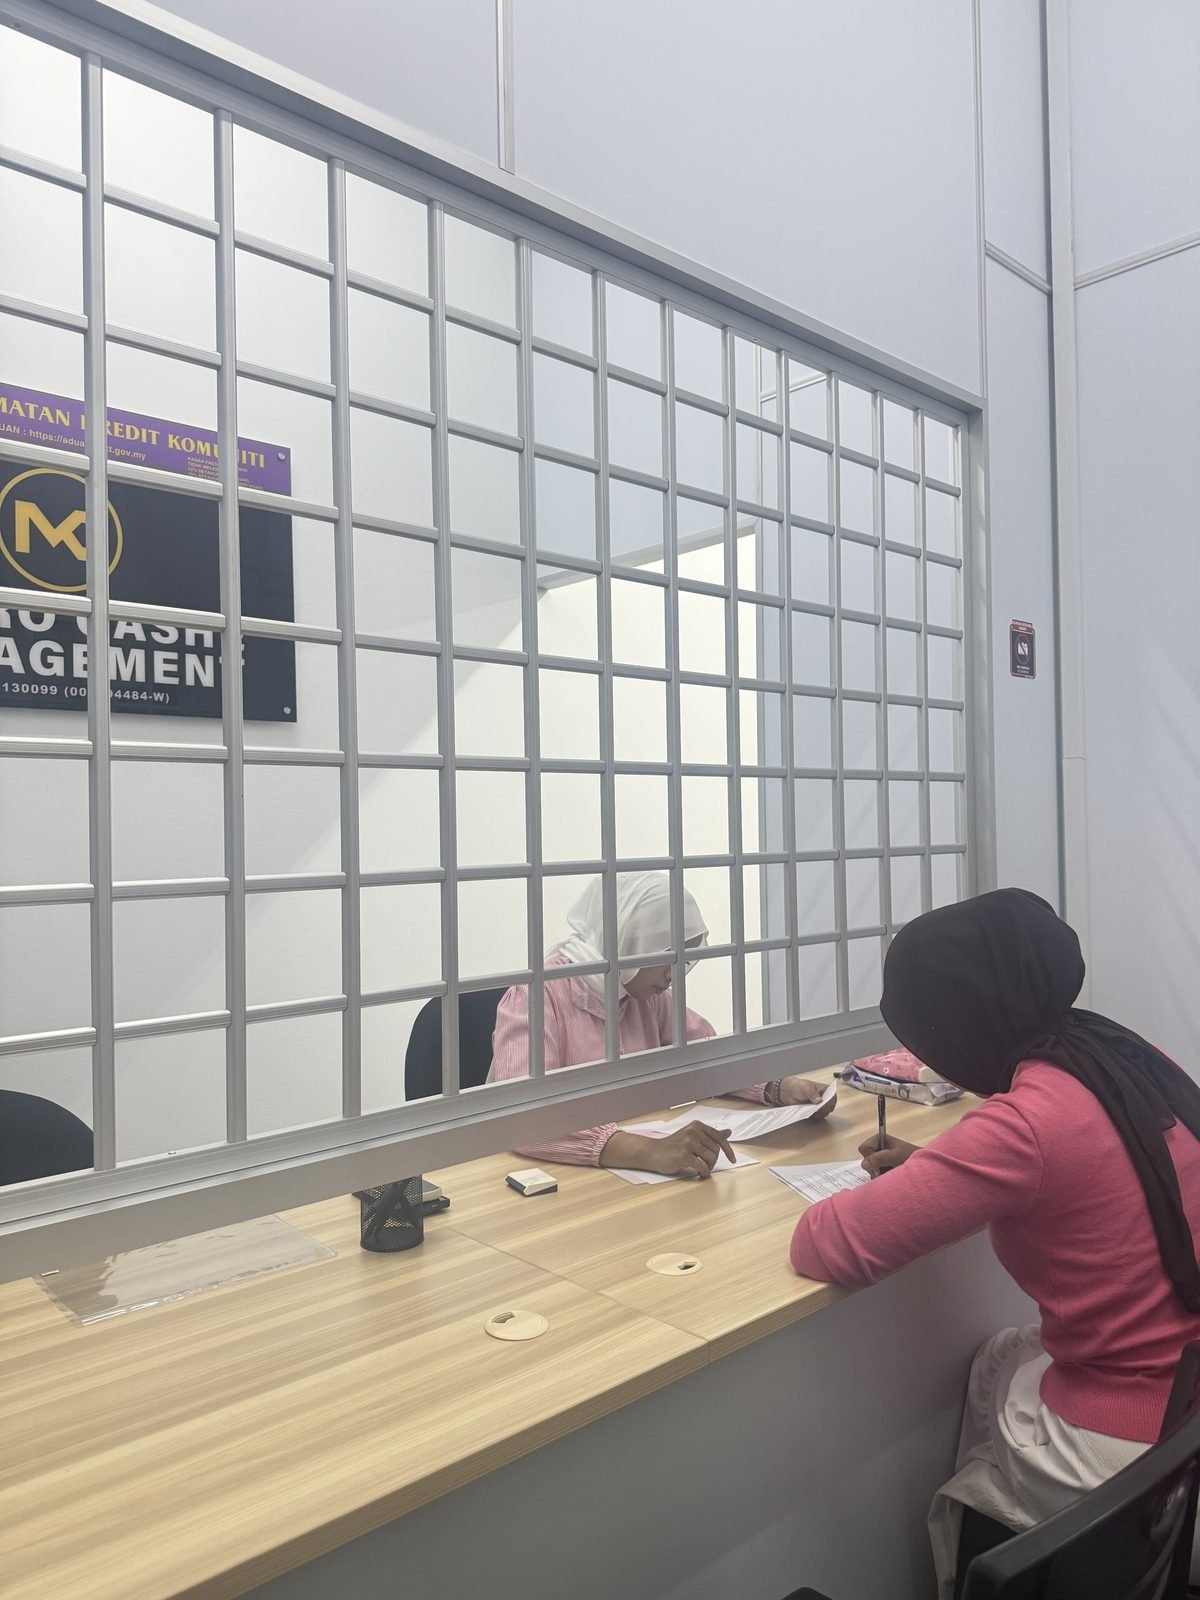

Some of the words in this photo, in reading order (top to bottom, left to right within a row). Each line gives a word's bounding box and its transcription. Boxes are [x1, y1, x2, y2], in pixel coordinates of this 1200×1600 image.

[168, 433, 265, 469] KOMITI
[76, 615, 214, 648] ASH
[0, 636, 245, 688] AGEMEN
[2, 682, 58, 695] 130099
[64, 686, 170, 704] (004484-W)
